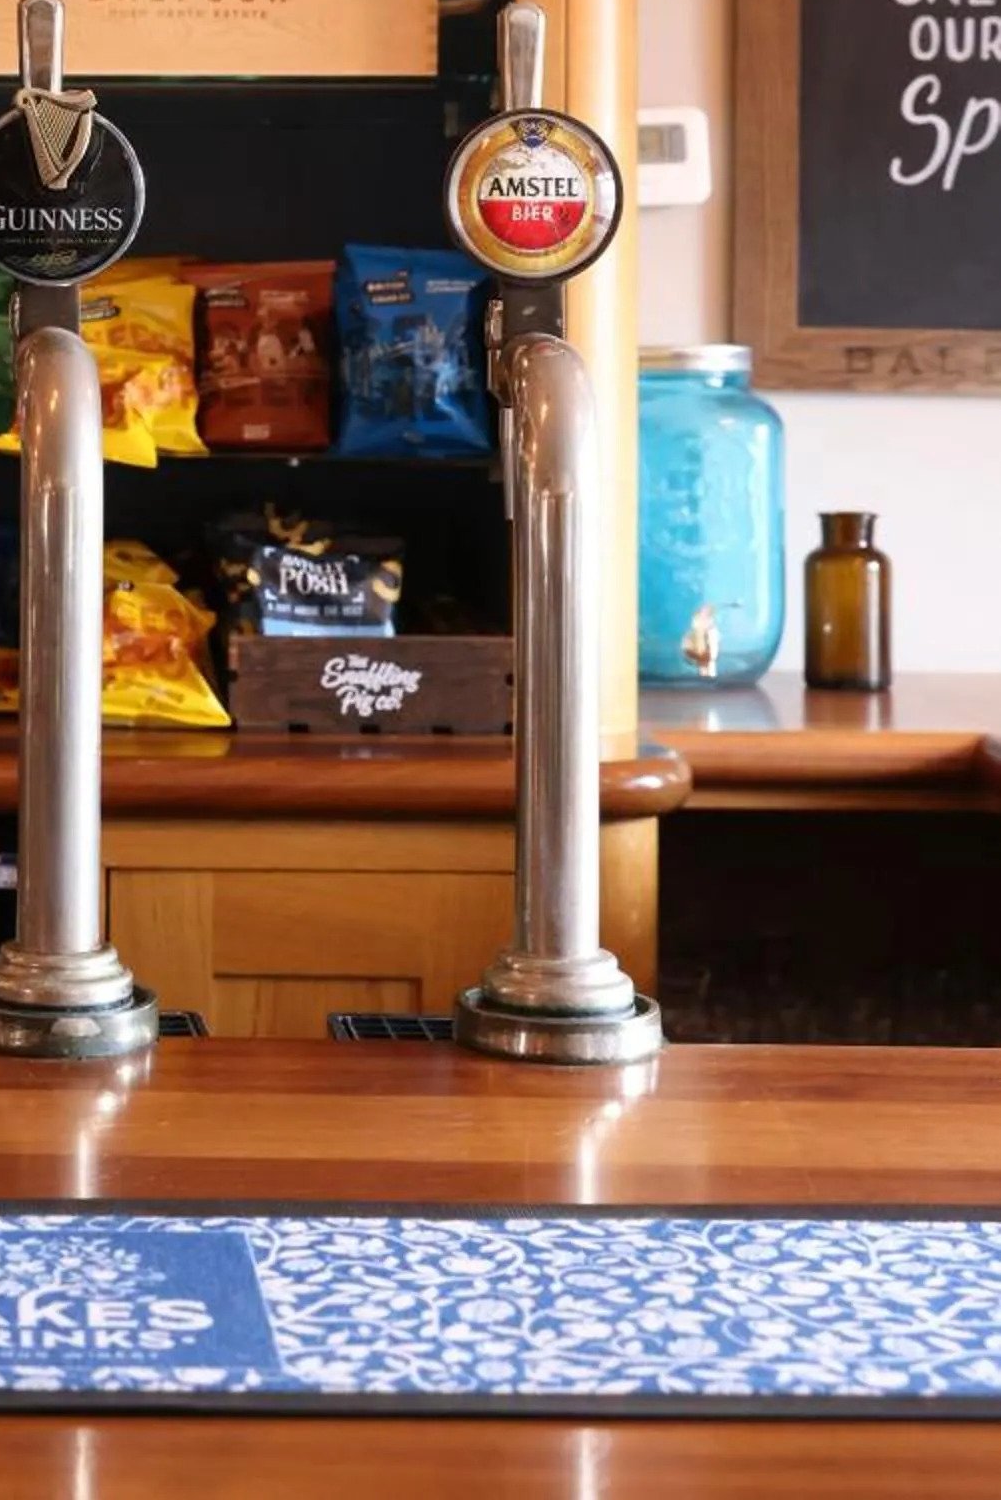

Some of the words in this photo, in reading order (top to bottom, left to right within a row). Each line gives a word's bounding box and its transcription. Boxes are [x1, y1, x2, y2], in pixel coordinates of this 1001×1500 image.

[909, 15, 1001, 62] OUR
[488, 177, 579, 198] AMSTEL
[511, 203, 554, 221] BIER
[278, 566, 350, 595] POSH
